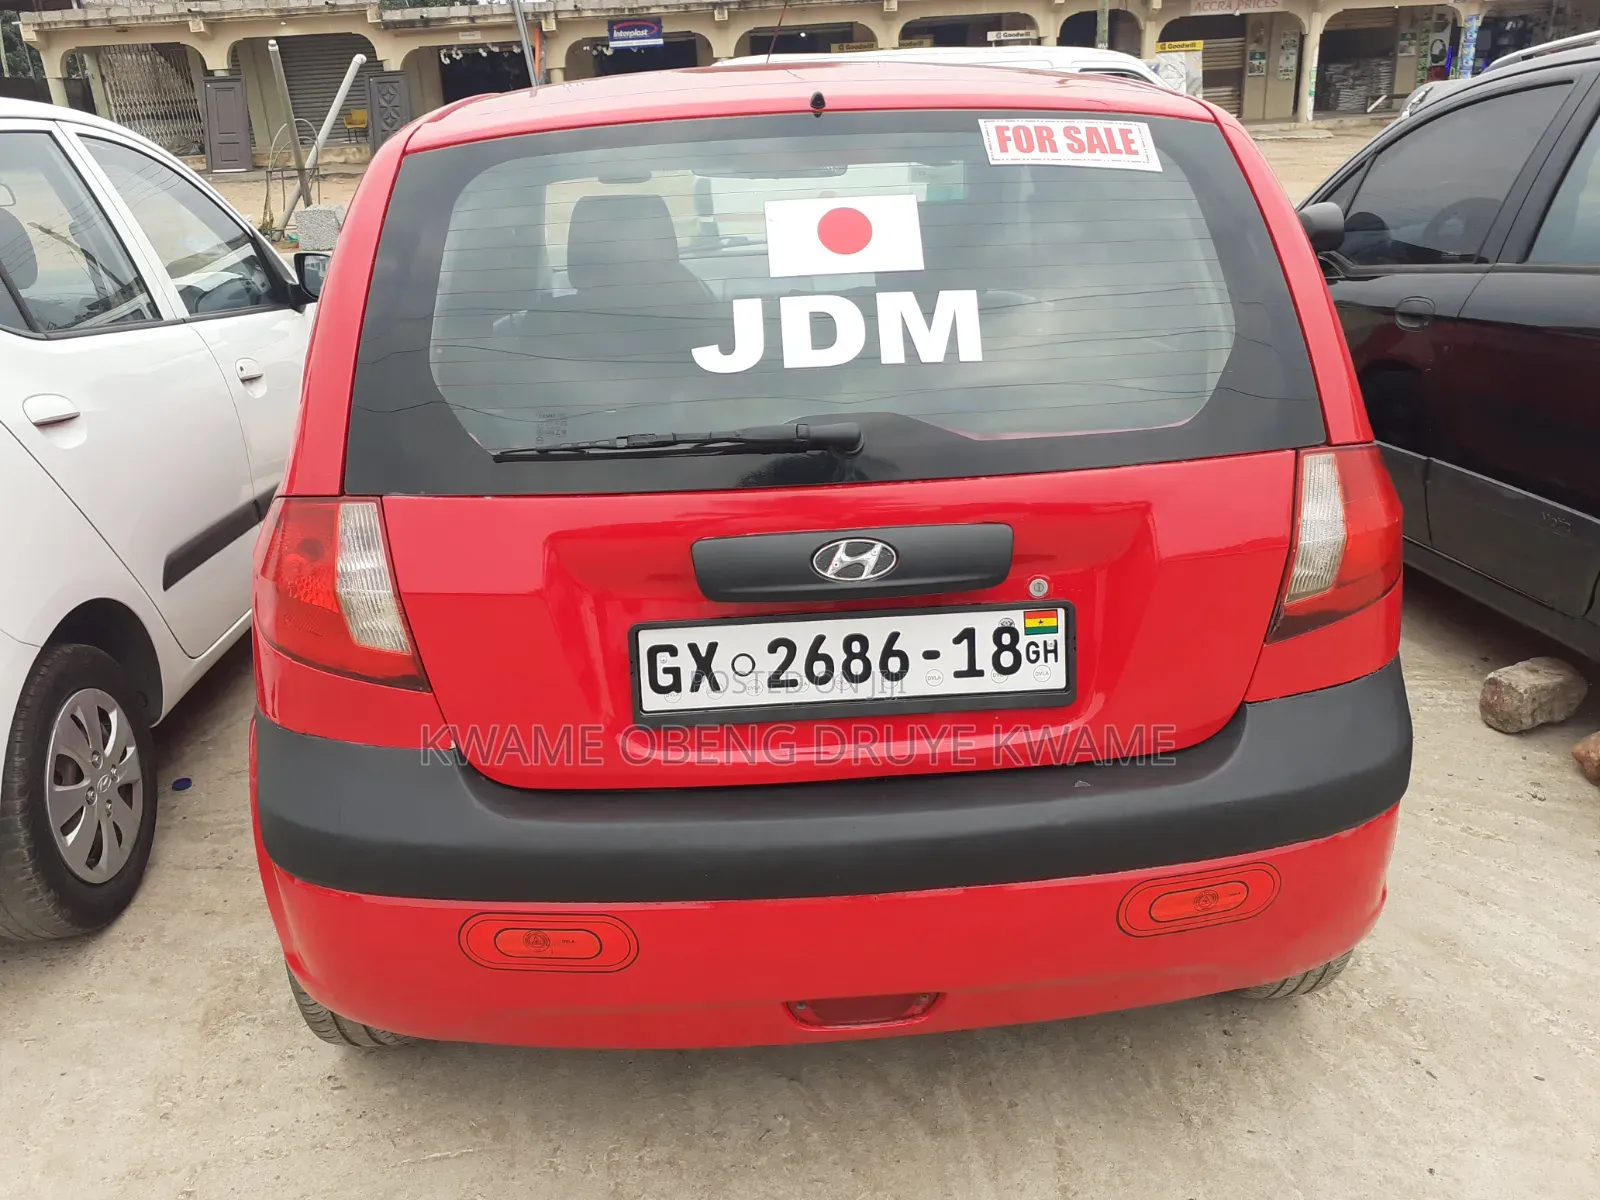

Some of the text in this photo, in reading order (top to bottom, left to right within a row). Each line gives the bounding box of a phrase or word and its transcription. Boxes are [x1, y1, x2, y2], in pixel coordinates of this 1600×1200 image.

[613, 29, 649, 38] Interplast
[899, 40, 924, 48] oodwill
[1167, 42, 1197, 50] Goodwill
[995, 125, 1139, 156] FOR SALE
[691, 289, 983, 373] JDM
[647, 626, 1022, 695] GX 2686-18
[1025, 639, 1059, 665] GH
